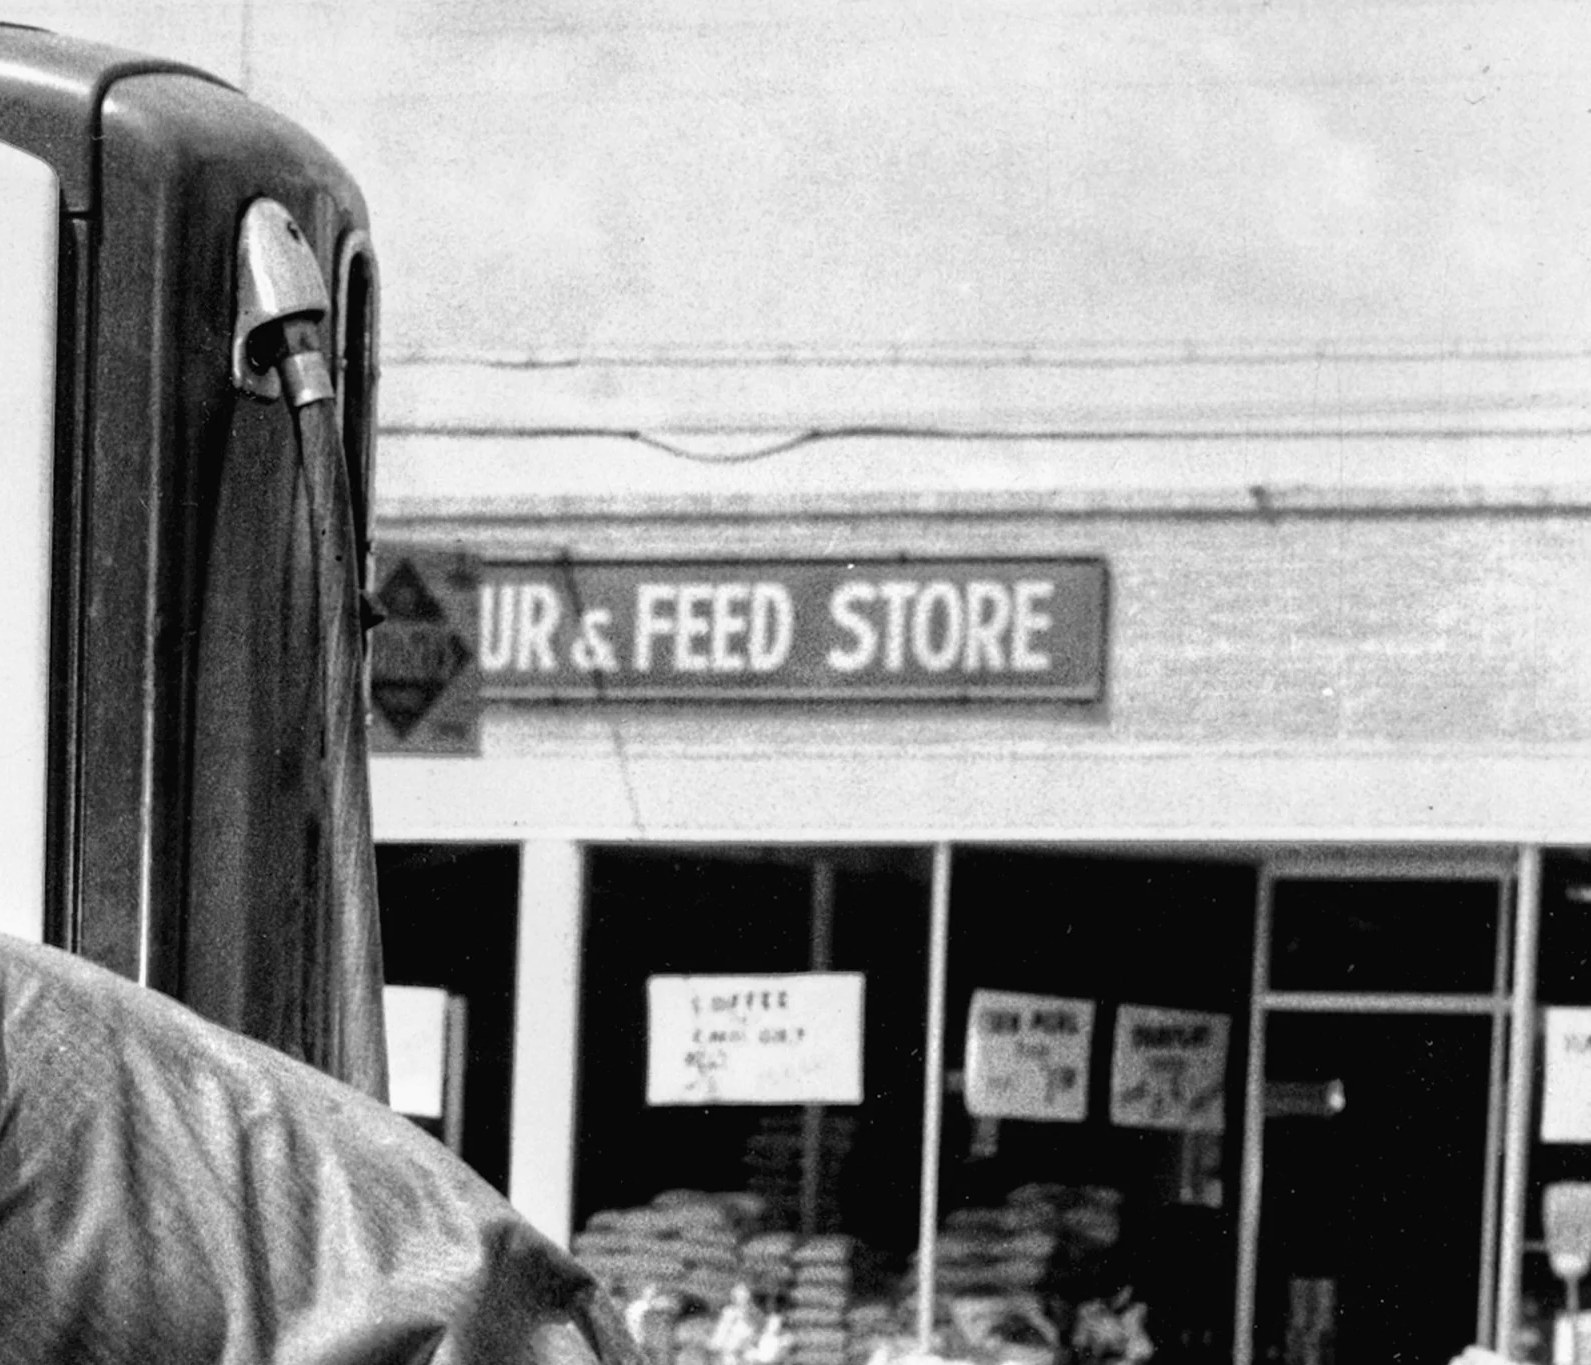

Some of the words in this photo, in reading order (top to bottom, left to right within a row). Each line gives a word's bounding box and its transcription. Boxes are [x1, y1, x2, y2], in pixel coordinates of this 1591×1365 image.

[570, 608, 619, 672] &
[633, 581, 795, 672] FEED
[827, 580, 1056, 672] STORE
